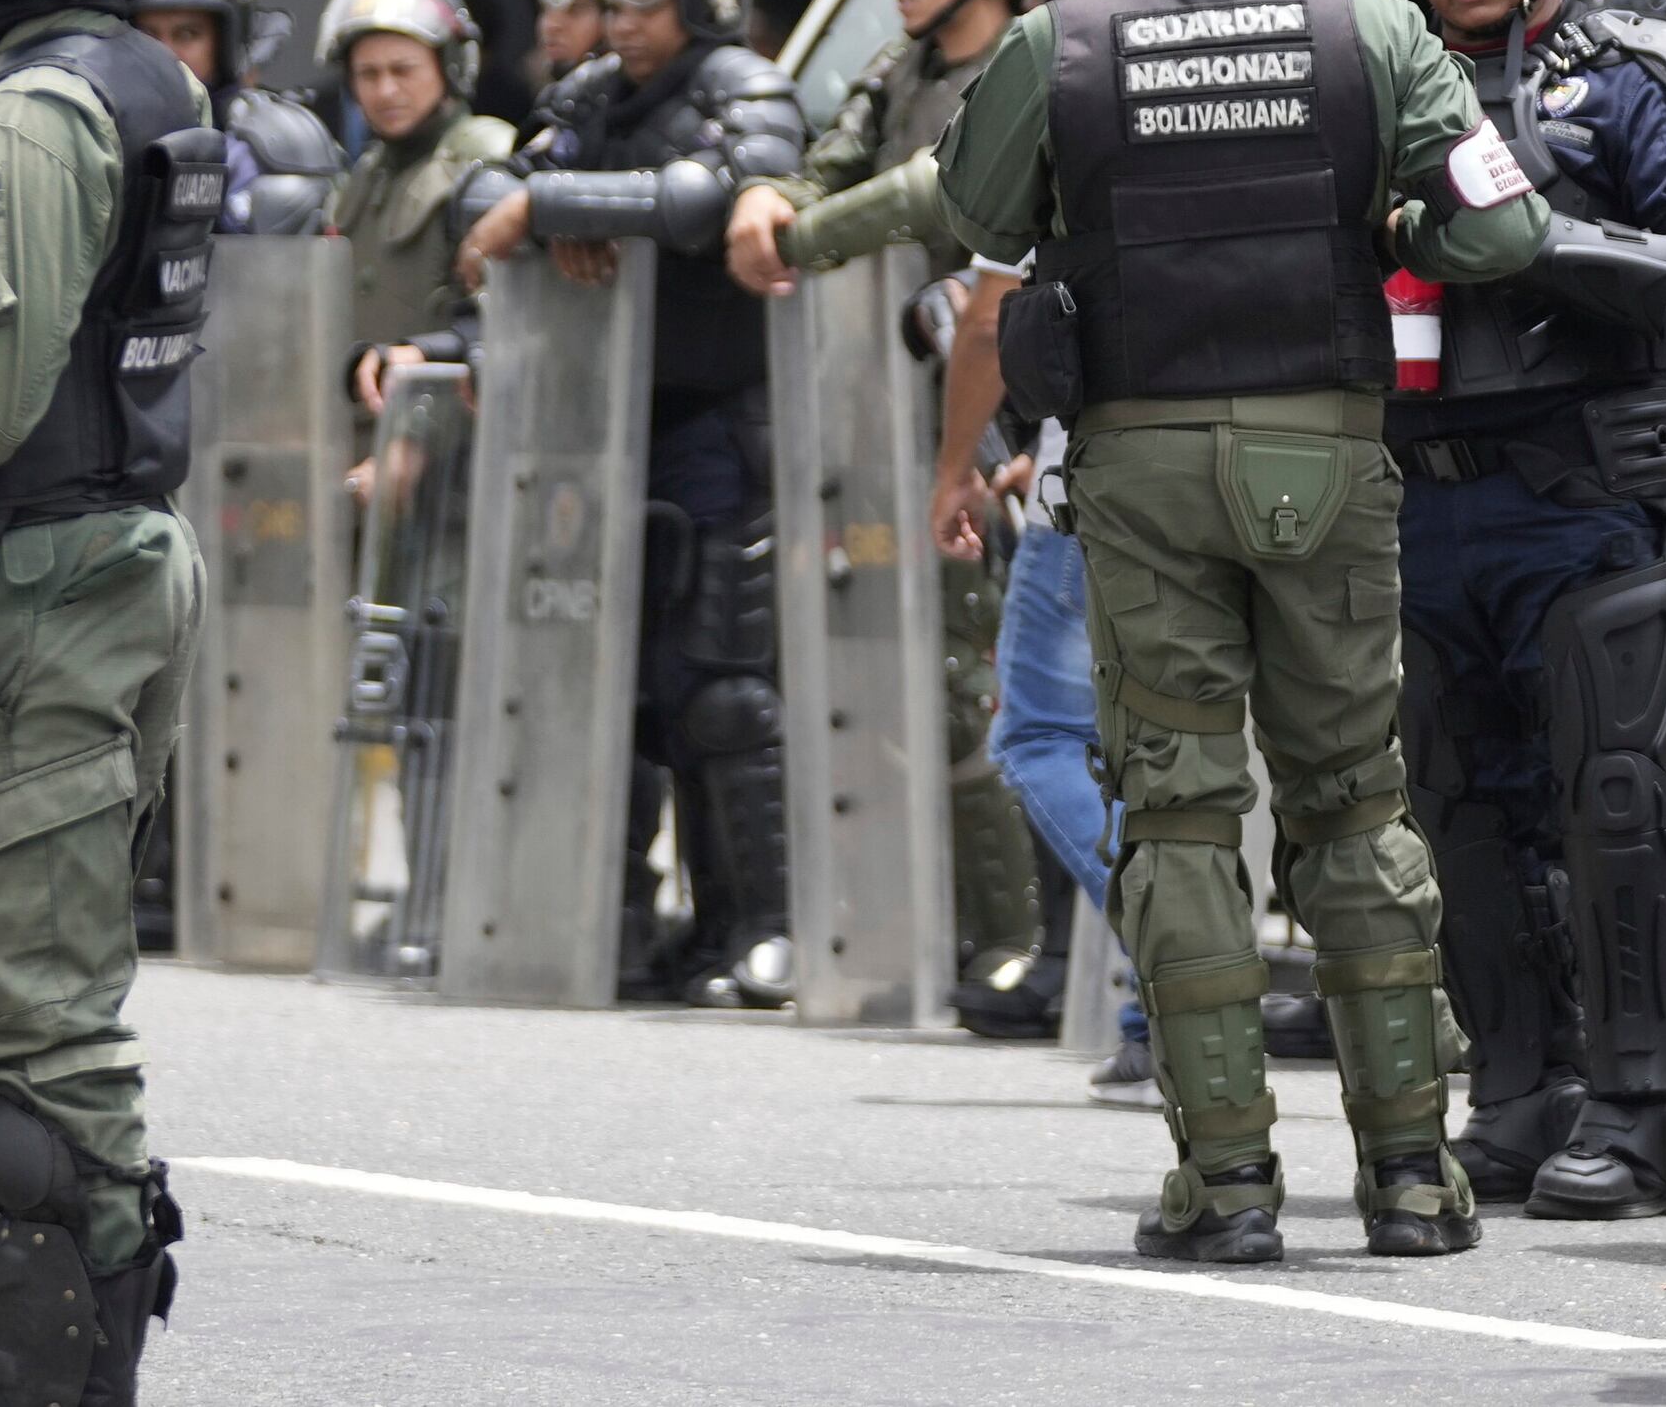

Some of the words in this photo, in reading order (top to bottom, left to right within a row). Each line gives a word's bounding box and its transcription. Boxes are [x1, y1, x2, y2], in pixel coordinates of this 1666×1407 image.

[1128, 4, 1304, 46] GUARDIA
[1129, 51, 1306, 92] NACIONAL
[1138, 98, 1305, 136] BOLIVARIANA
